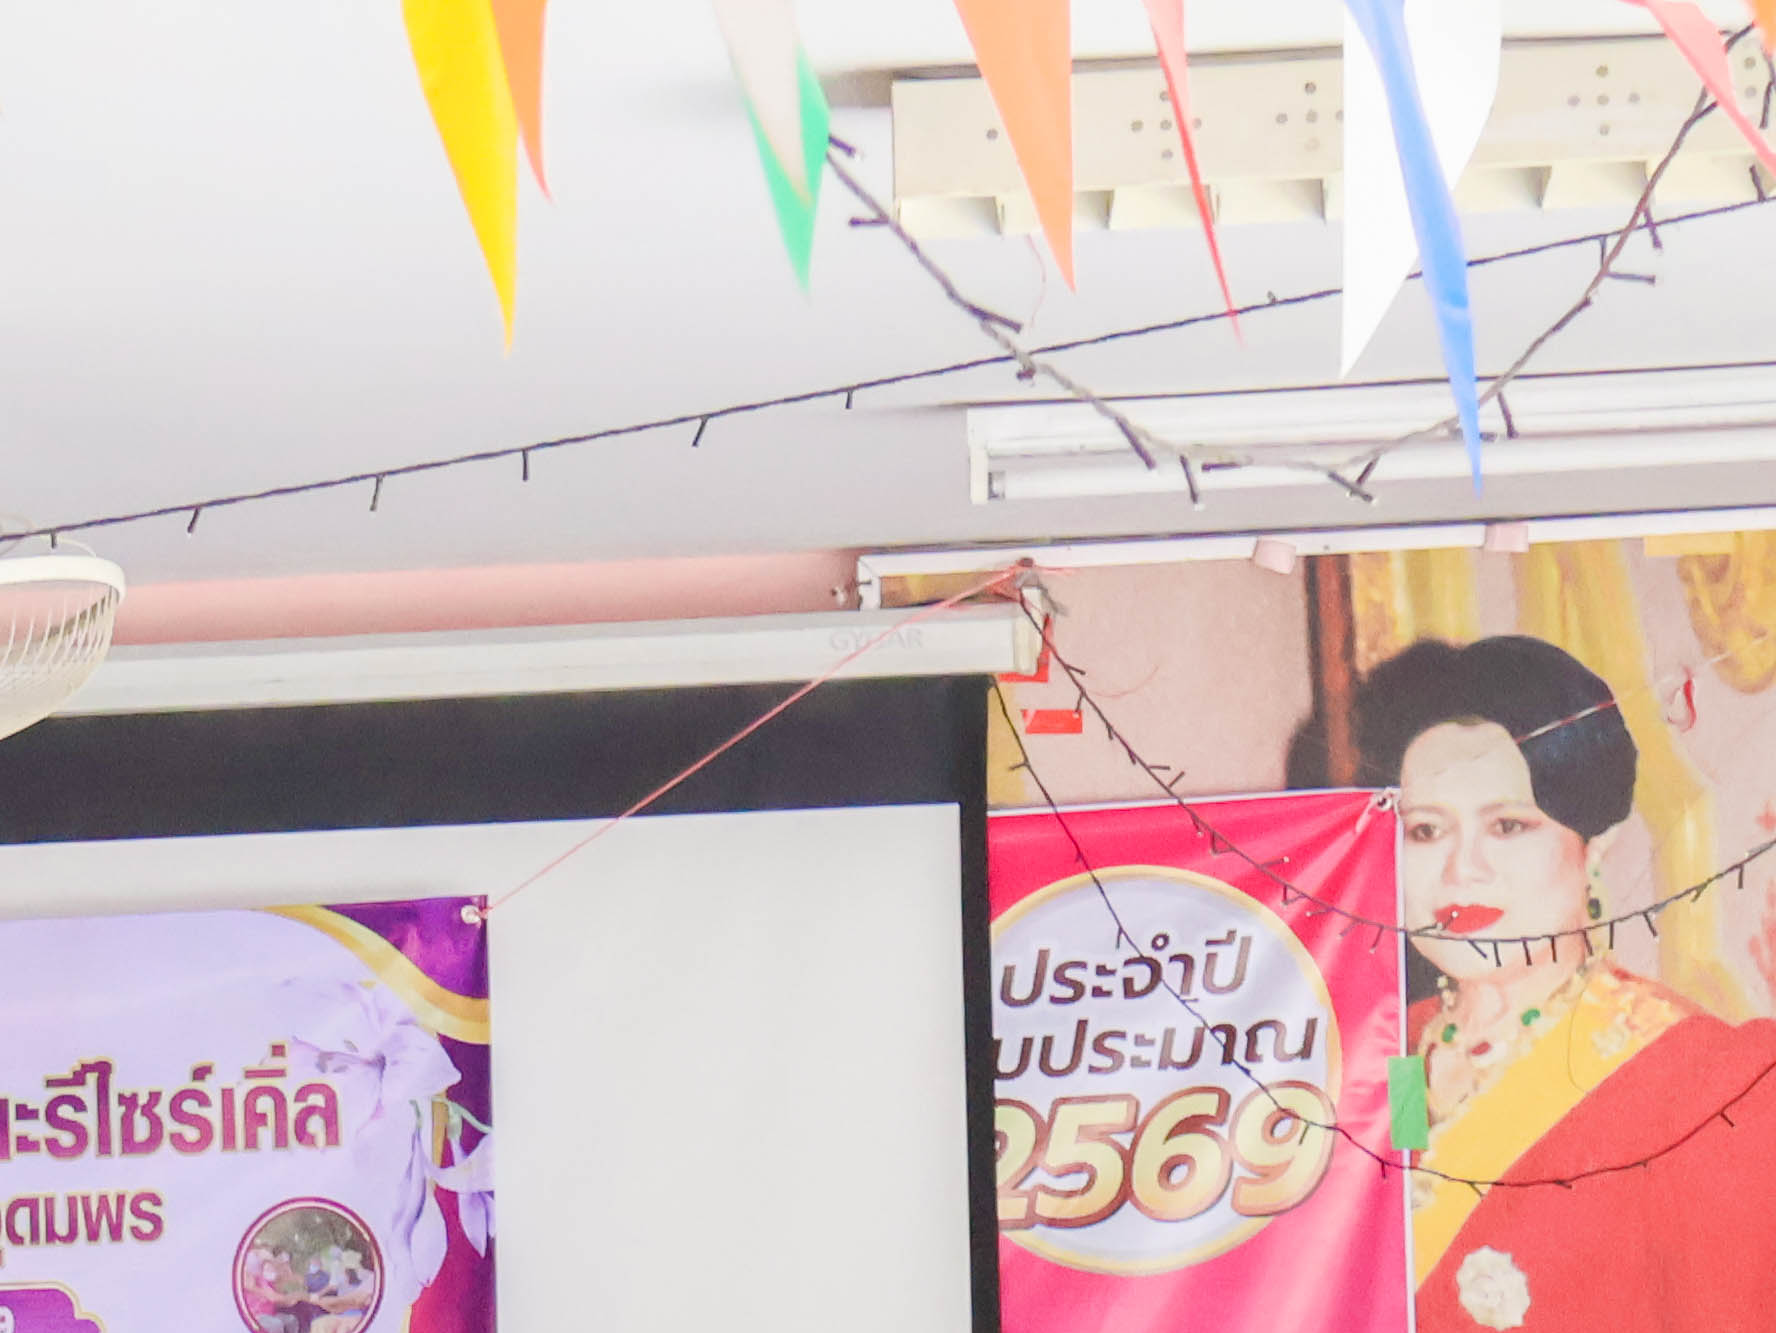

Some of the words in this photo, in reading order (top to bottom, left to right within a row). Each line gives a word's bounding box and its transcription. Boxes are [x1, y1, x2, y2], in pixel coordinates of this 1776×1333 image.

[999, 930, 1252, 1008] ประจำปี
[994, 1080, 1336, 1229] 2569
